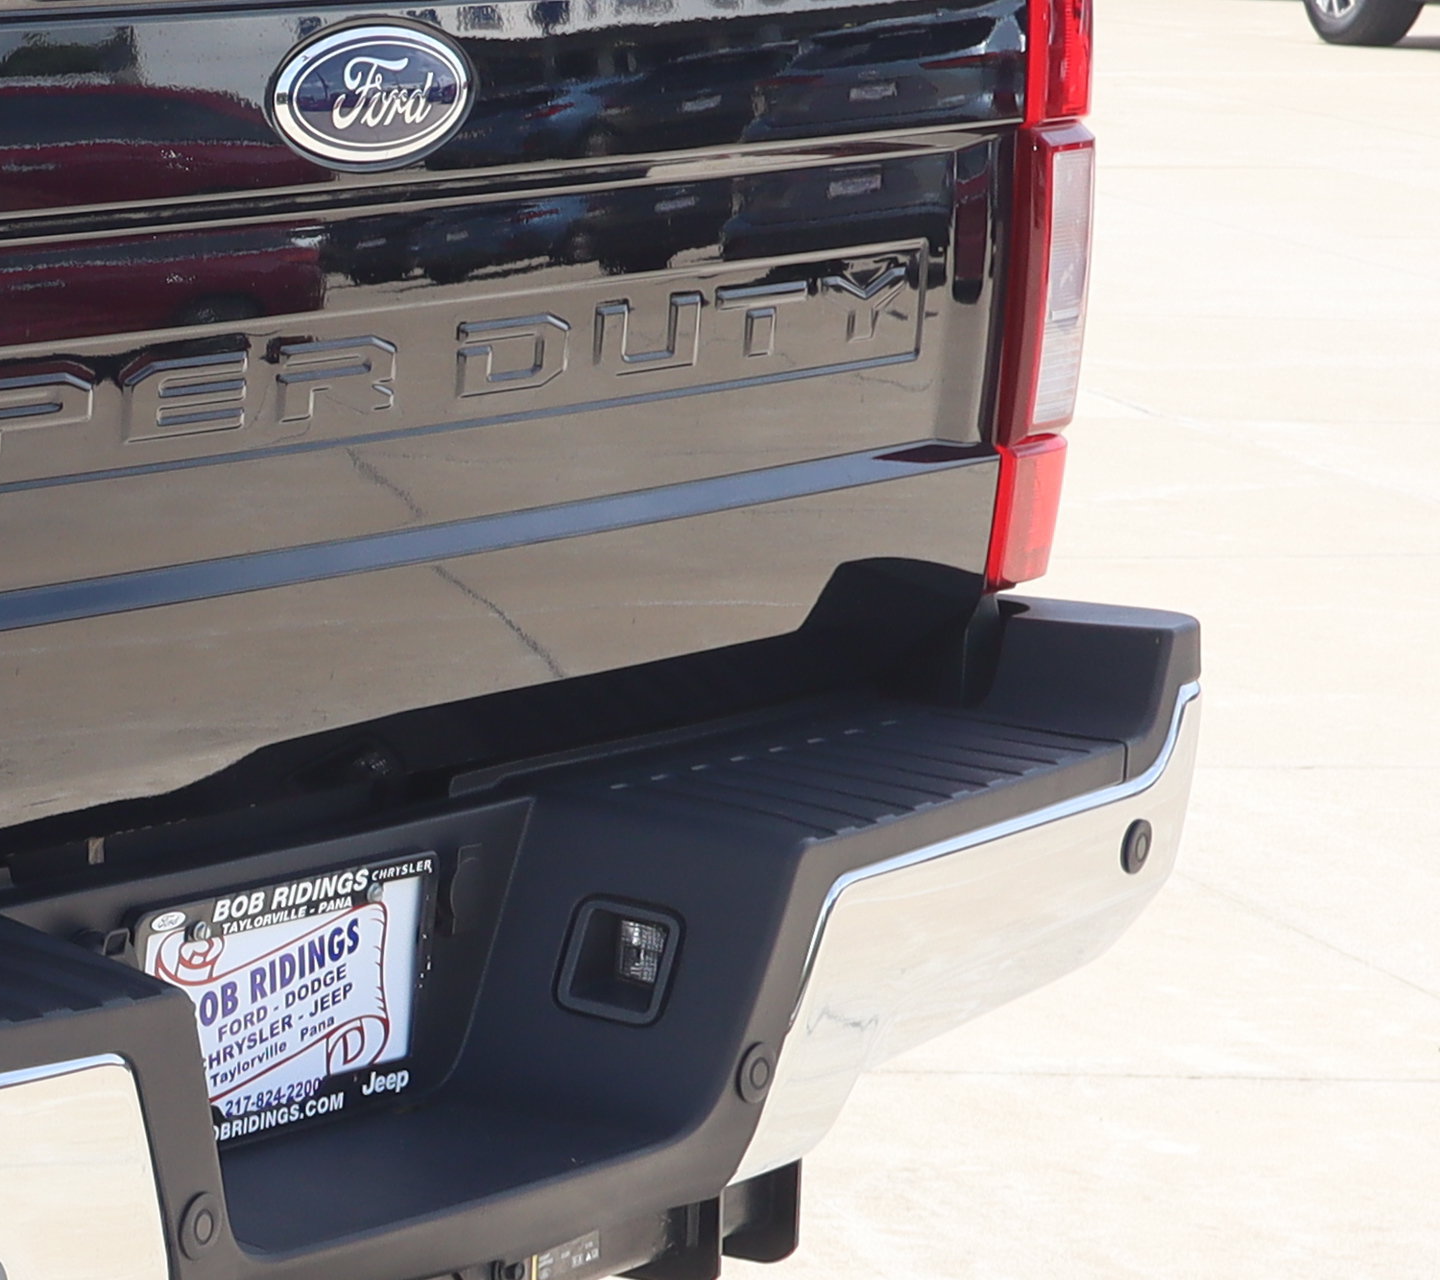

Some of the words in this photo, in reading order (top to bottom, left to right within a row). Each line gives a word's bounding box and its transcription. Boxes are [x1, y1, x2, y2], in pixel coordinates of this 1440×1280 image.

[331, 55, 433, 128] Ford
[454, 258, 916, 398] DUTY
[212, 891, 265, 923] BOB
[271, 869, 369, 911] RIDINGS
[371, 859, 433, 881] CHRYSLER
[222, 907, 307, 935] TAYLORVILLE
[318, 896, 352, 915] PANA
[199, 981, 239, 1027] OB
[250, 918, 361, 1001] RIDINGS
[218, 1006, 269, 1043] FORD
[284, 963, 348, 1010] DODGE
[202, 1014, 294, 1071] HRYSLER
[308, 983, 353, 1020] JEEP
[210, 1040, 287, 1089] Taylorville
[300, 1016, 335, 1042] Pana
[224, 1077, 321, 1118] 217-824-2200
[361, 1068, 410, 1098] Jeep
